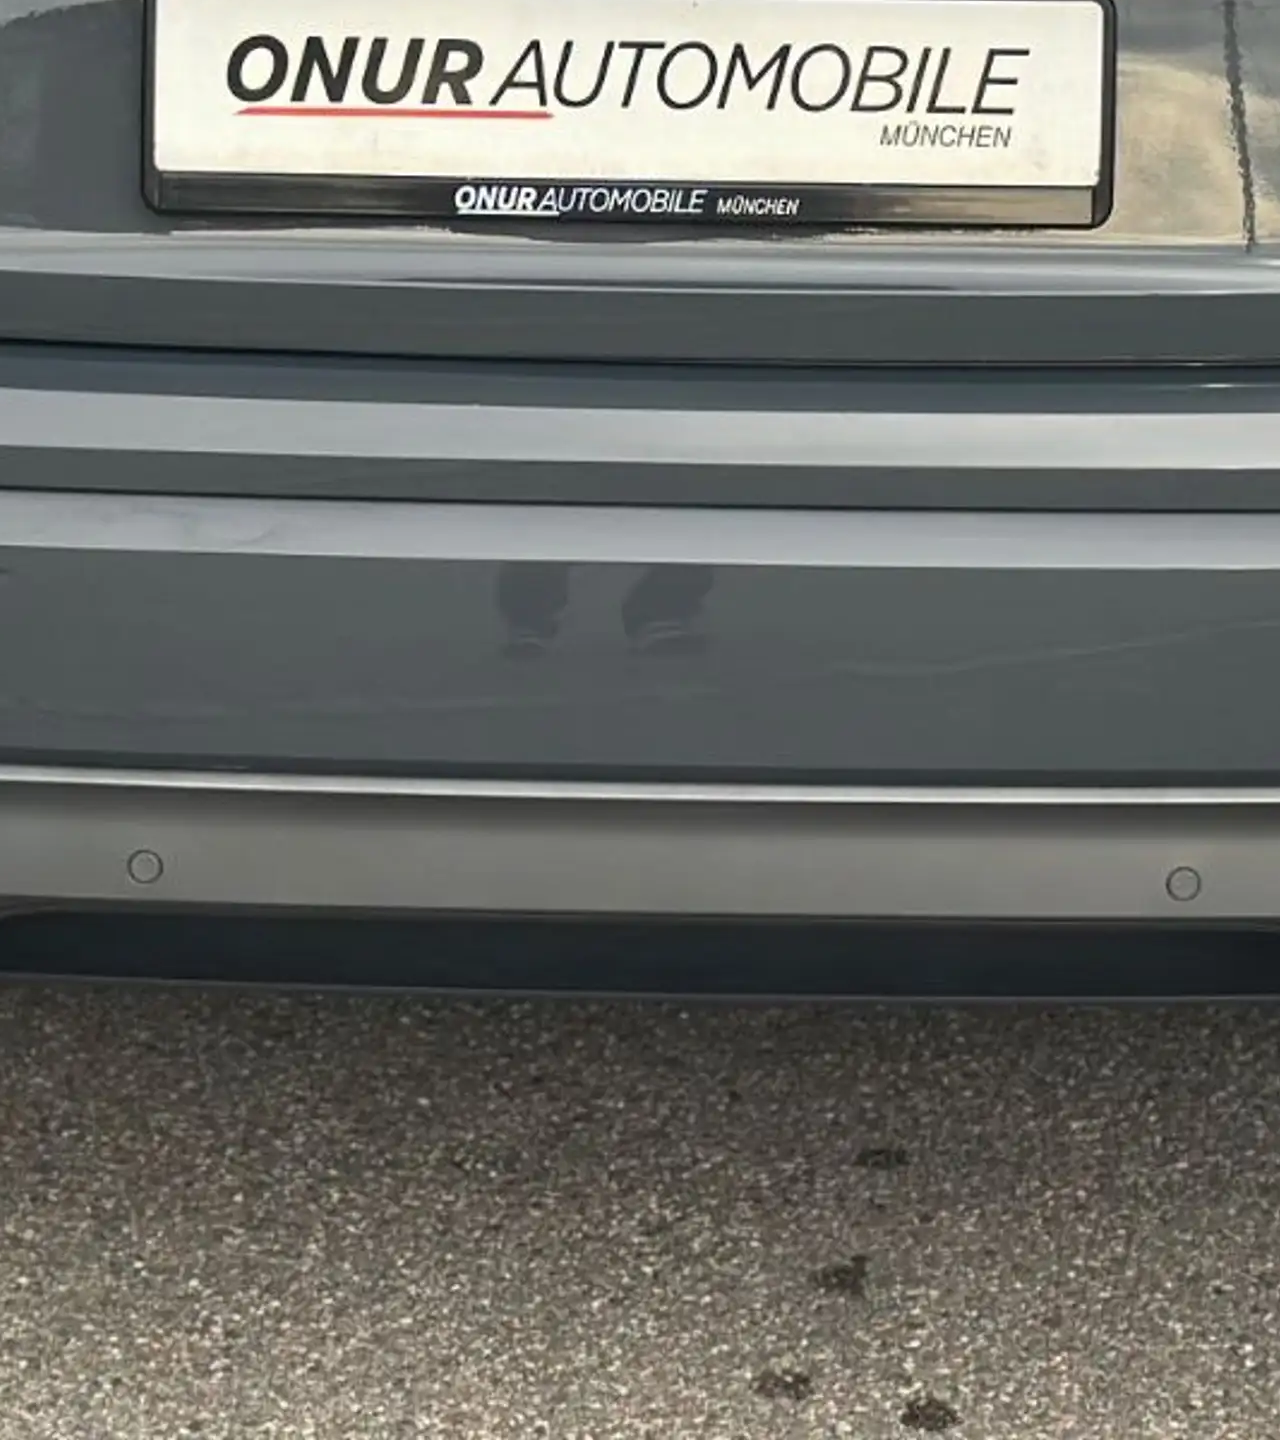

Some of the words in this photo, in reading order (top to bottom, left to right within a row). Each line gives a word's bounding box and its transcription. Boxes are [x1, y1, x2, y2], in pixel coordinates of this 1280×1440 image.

[227, 34, 484, 106] ONUR
[488, 39, 1030, 115] AUTOMOBILE
[878, 120, 1013, 149] MÜNCHEN
[716, 194, 800, 216] MÜNCHEN
